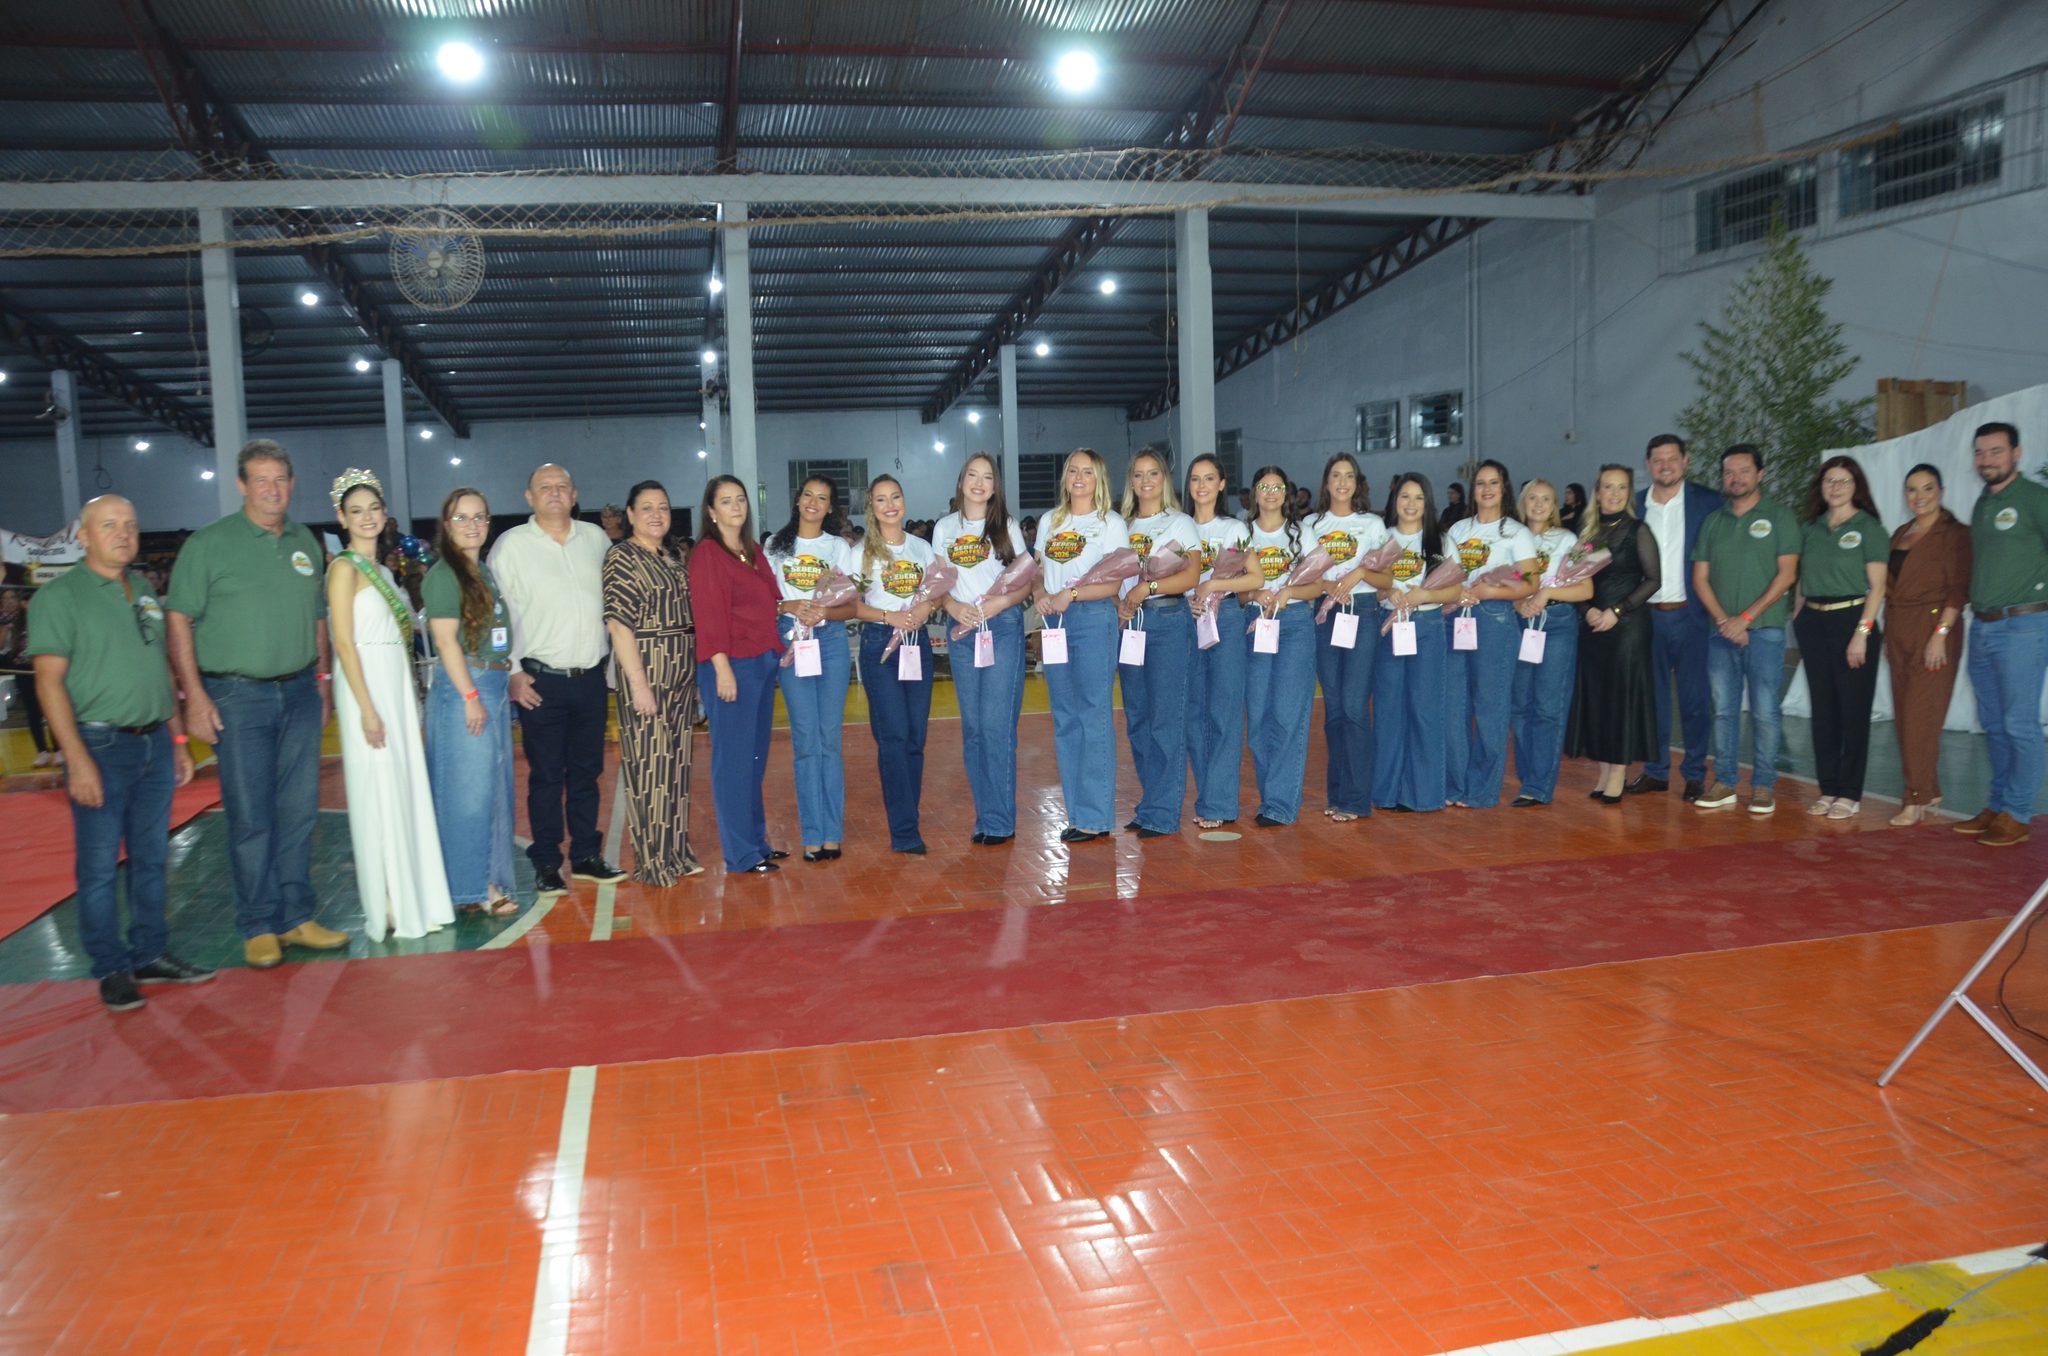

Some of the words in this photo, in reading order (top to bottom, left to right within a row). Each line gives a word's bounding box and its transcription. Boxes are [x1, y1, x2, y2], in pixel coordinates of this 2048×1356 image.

[953, 544, 982, 552] SEBERI
[959, 555, 977, 563] 2026
[796, 578, 815, 586] 2026
[895, 585, 913, 593] 2026
